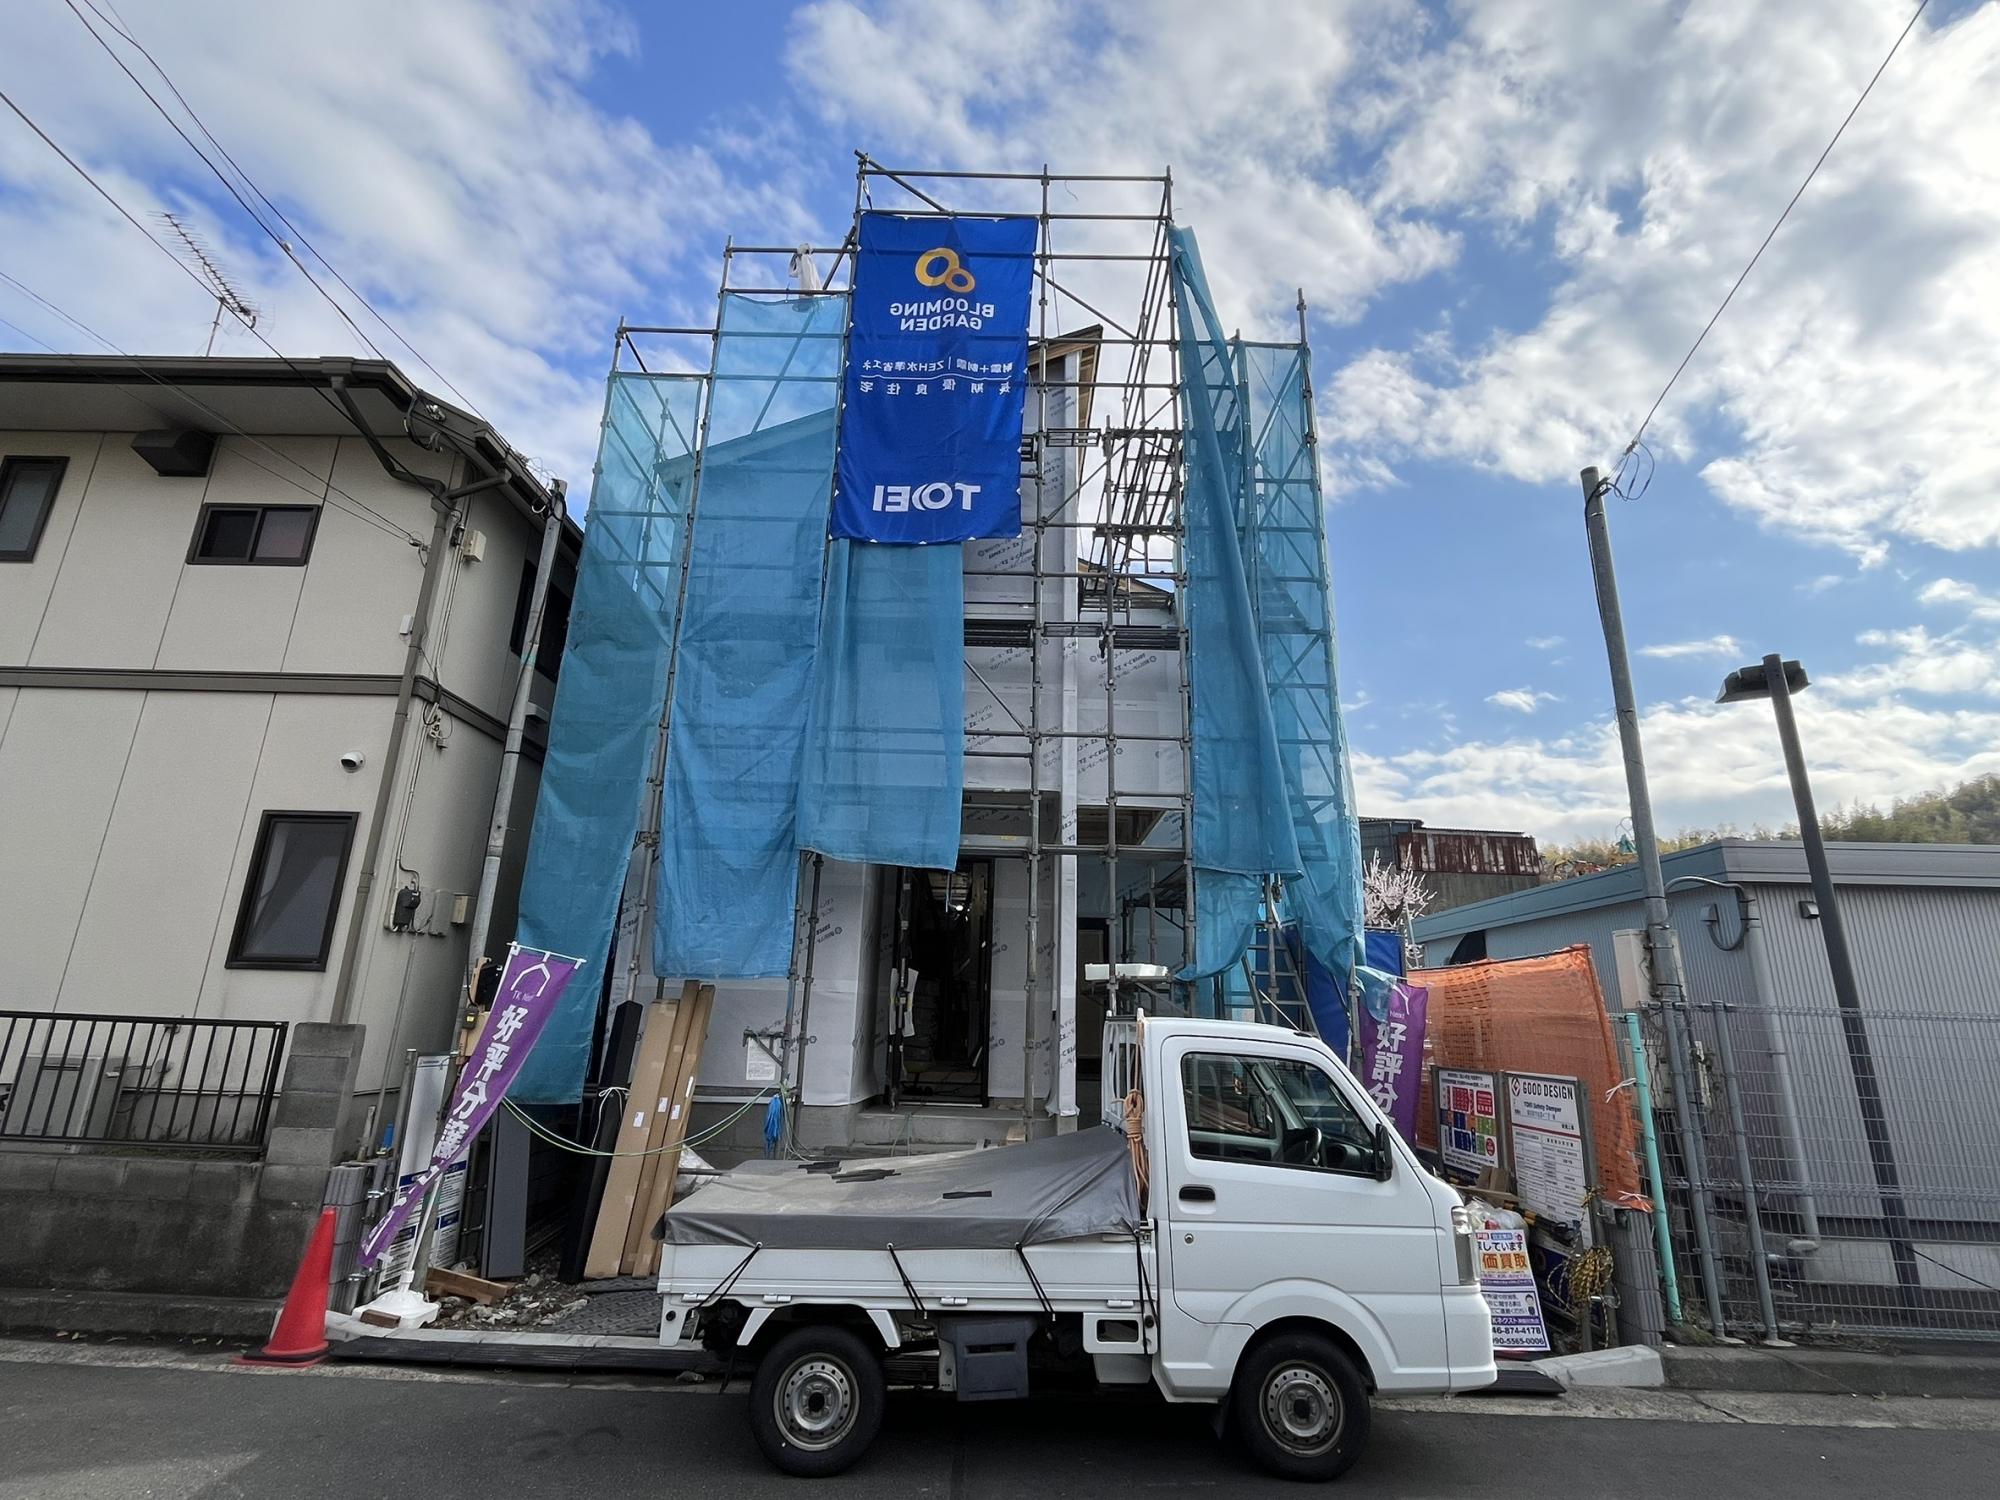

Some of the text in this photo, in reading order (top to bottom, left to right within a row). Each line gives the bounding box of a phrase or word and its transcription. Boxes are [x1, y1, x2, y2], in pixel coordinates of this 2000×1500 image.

[1368, 1022, 1407, 1119] 好評分
[1522, 1081, 1574, 1100] GOOD DESIGN
